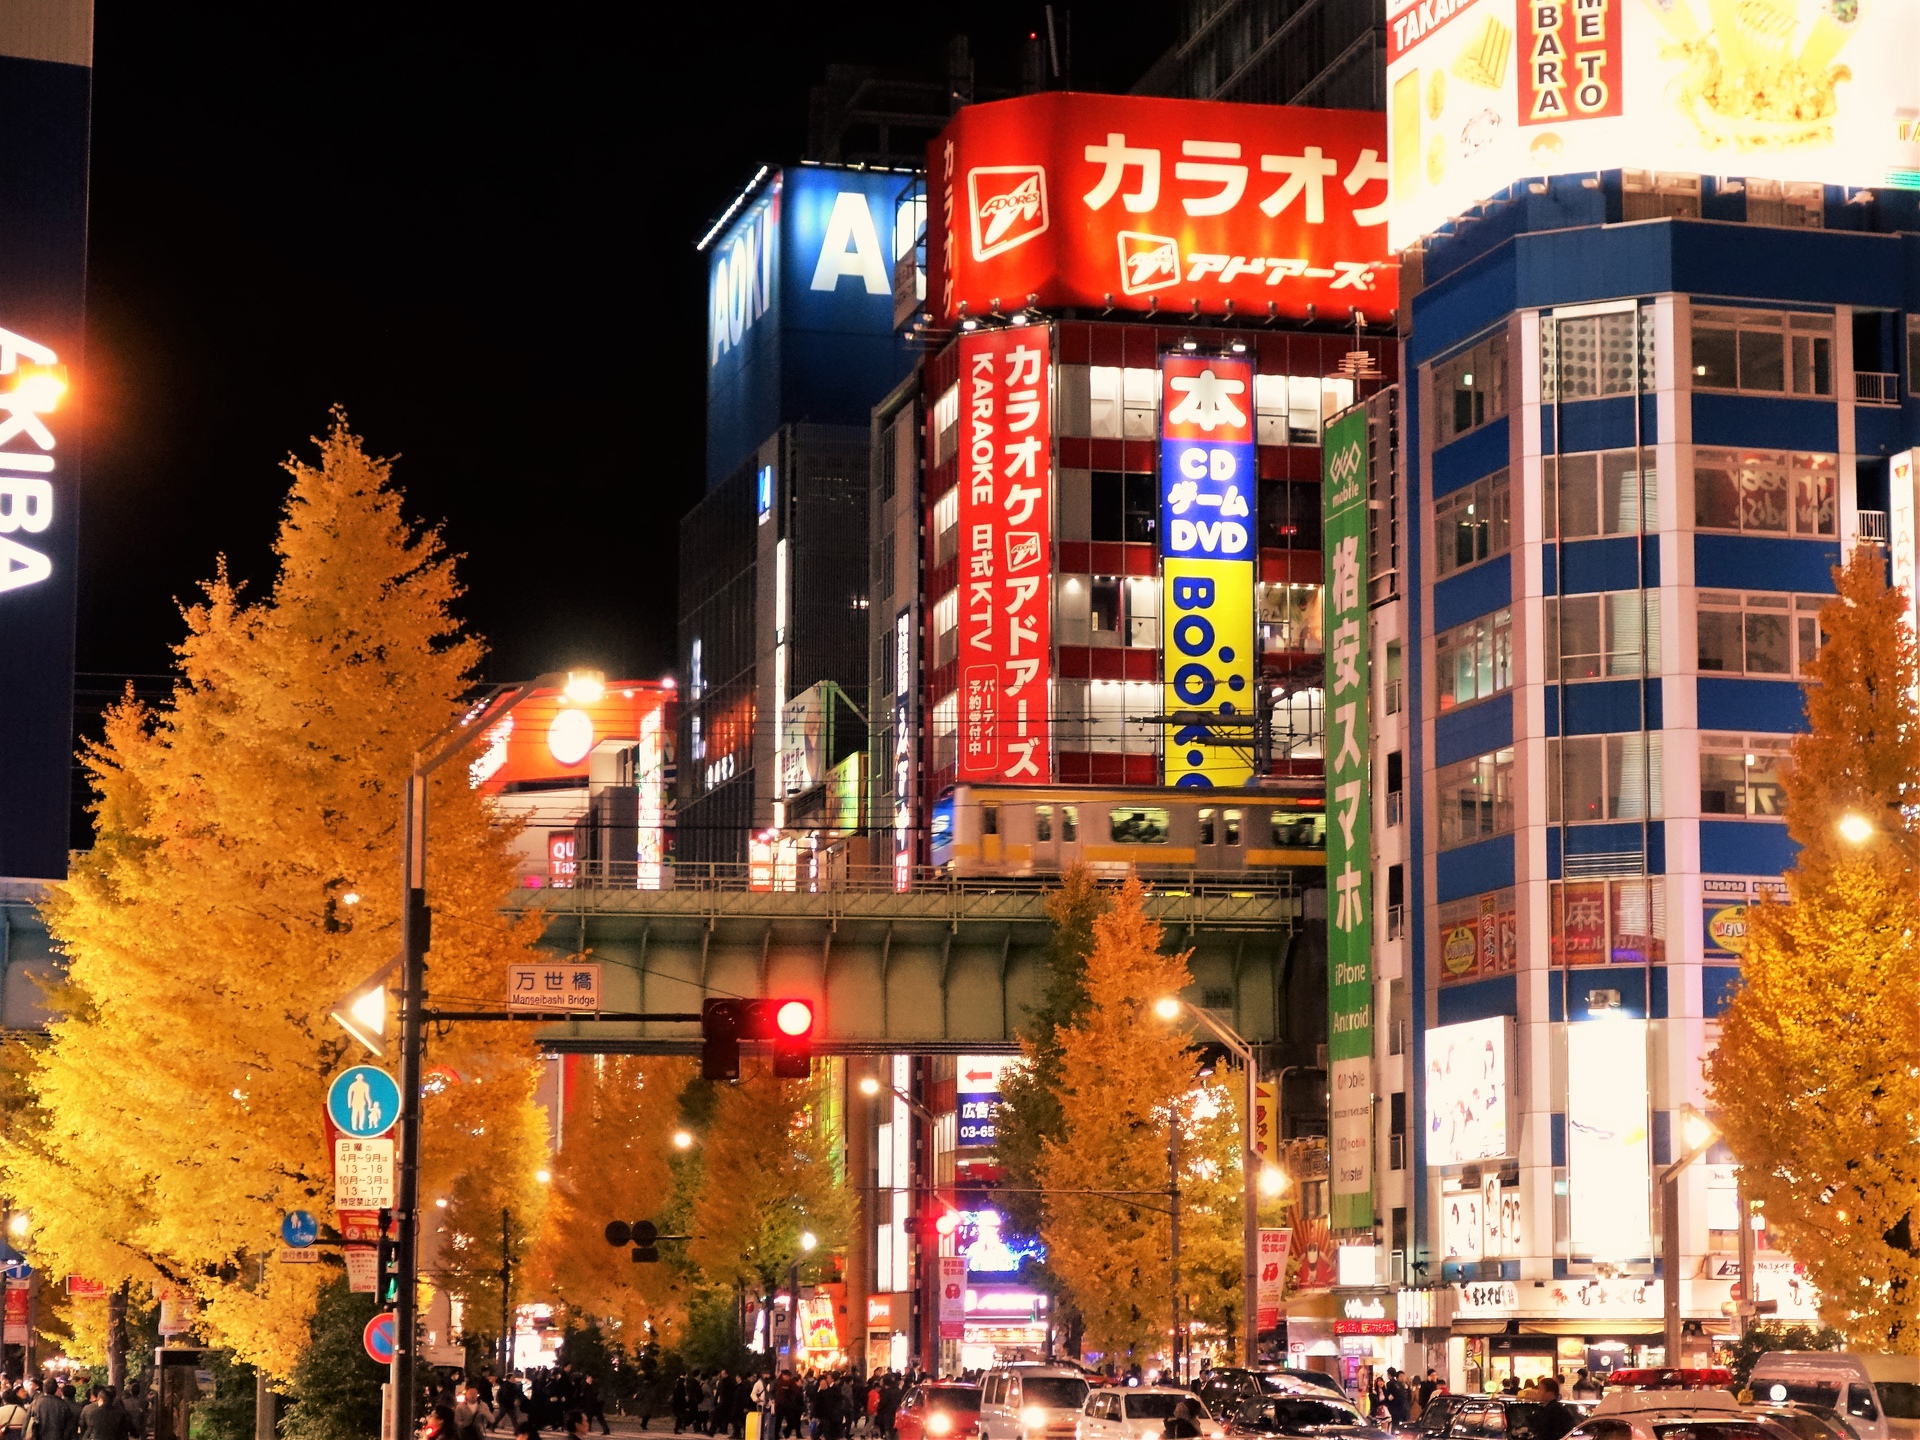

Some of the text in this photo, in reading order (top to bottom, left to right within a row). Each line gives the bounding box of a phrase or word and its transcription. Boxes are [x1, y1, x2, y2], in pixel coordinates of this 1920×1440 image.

[712, 204, 773, 368] AOKI
[1169, 369, 1247, 432] 本
[971, 352, 994, 506] KARAOKE
[1179, 447, 1236, 481] CD
[1003, 344, 1042, 778] カラオケ アドアーズ
[1171, 519, 1248, 554] DVD
[1332, 535, 1364, 933] 格安スマホ
[516, 971, 592, 991] 万世橋
[1335, 962, 1366, 987] iPhone
[512, 994, 595, 1007] Manseibashi Bridge
